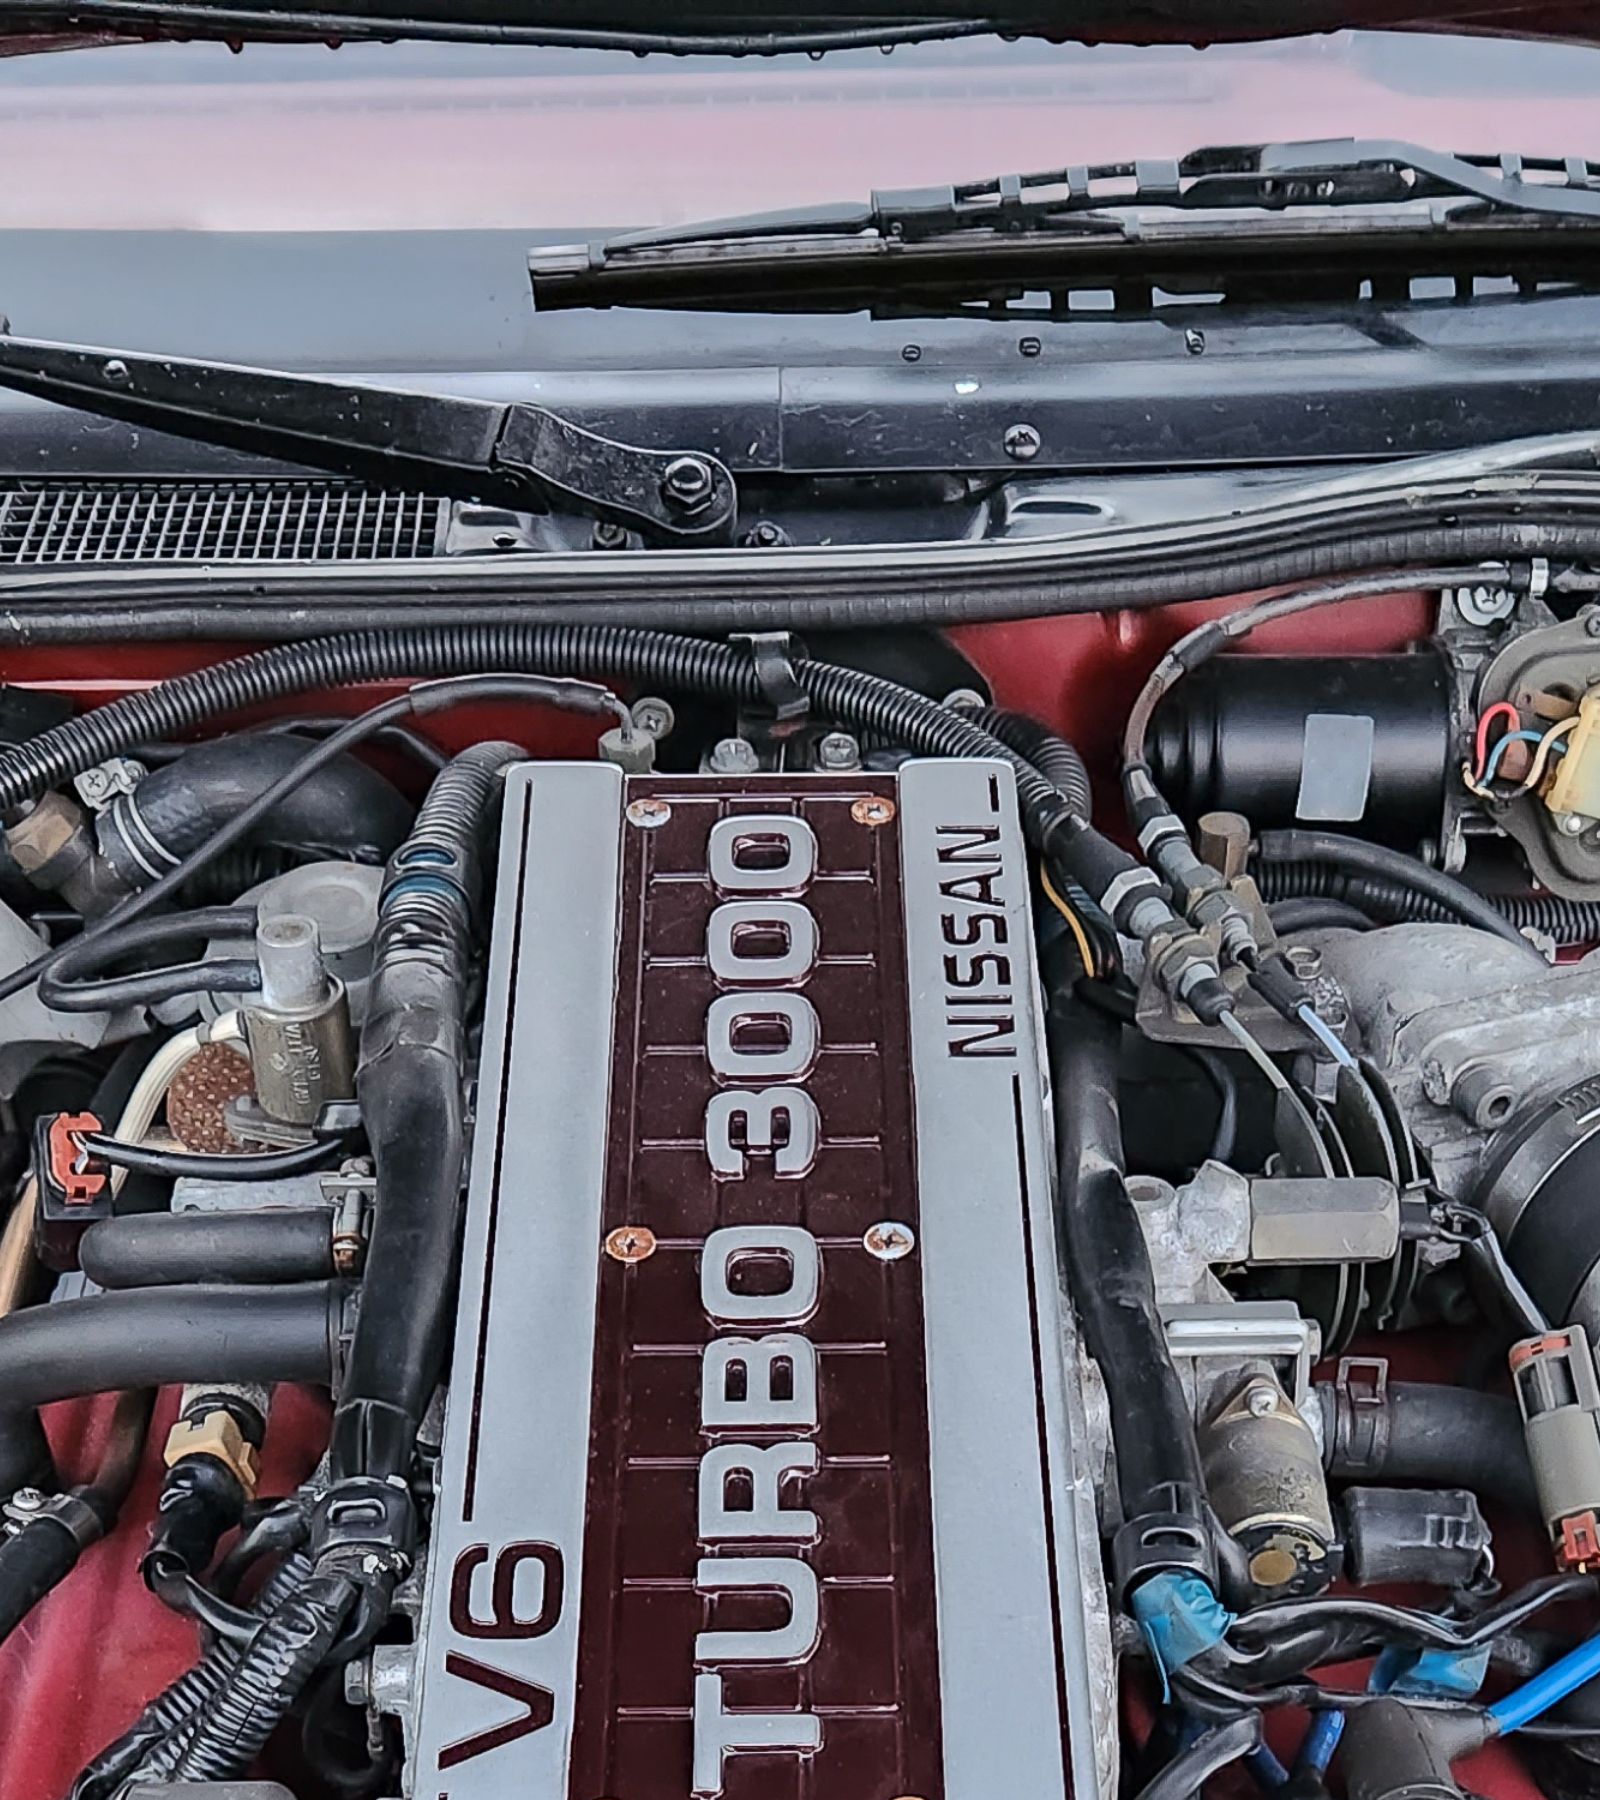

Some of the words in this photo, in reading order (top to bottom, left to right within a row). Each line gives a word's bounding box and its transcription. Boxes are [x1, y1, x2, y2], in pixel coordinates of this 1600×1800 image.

[702, 812, 823, 1185] 3000
[935, 822, 1020, 1060] NISSAN
[437, 1539, 565, 1771] V6
